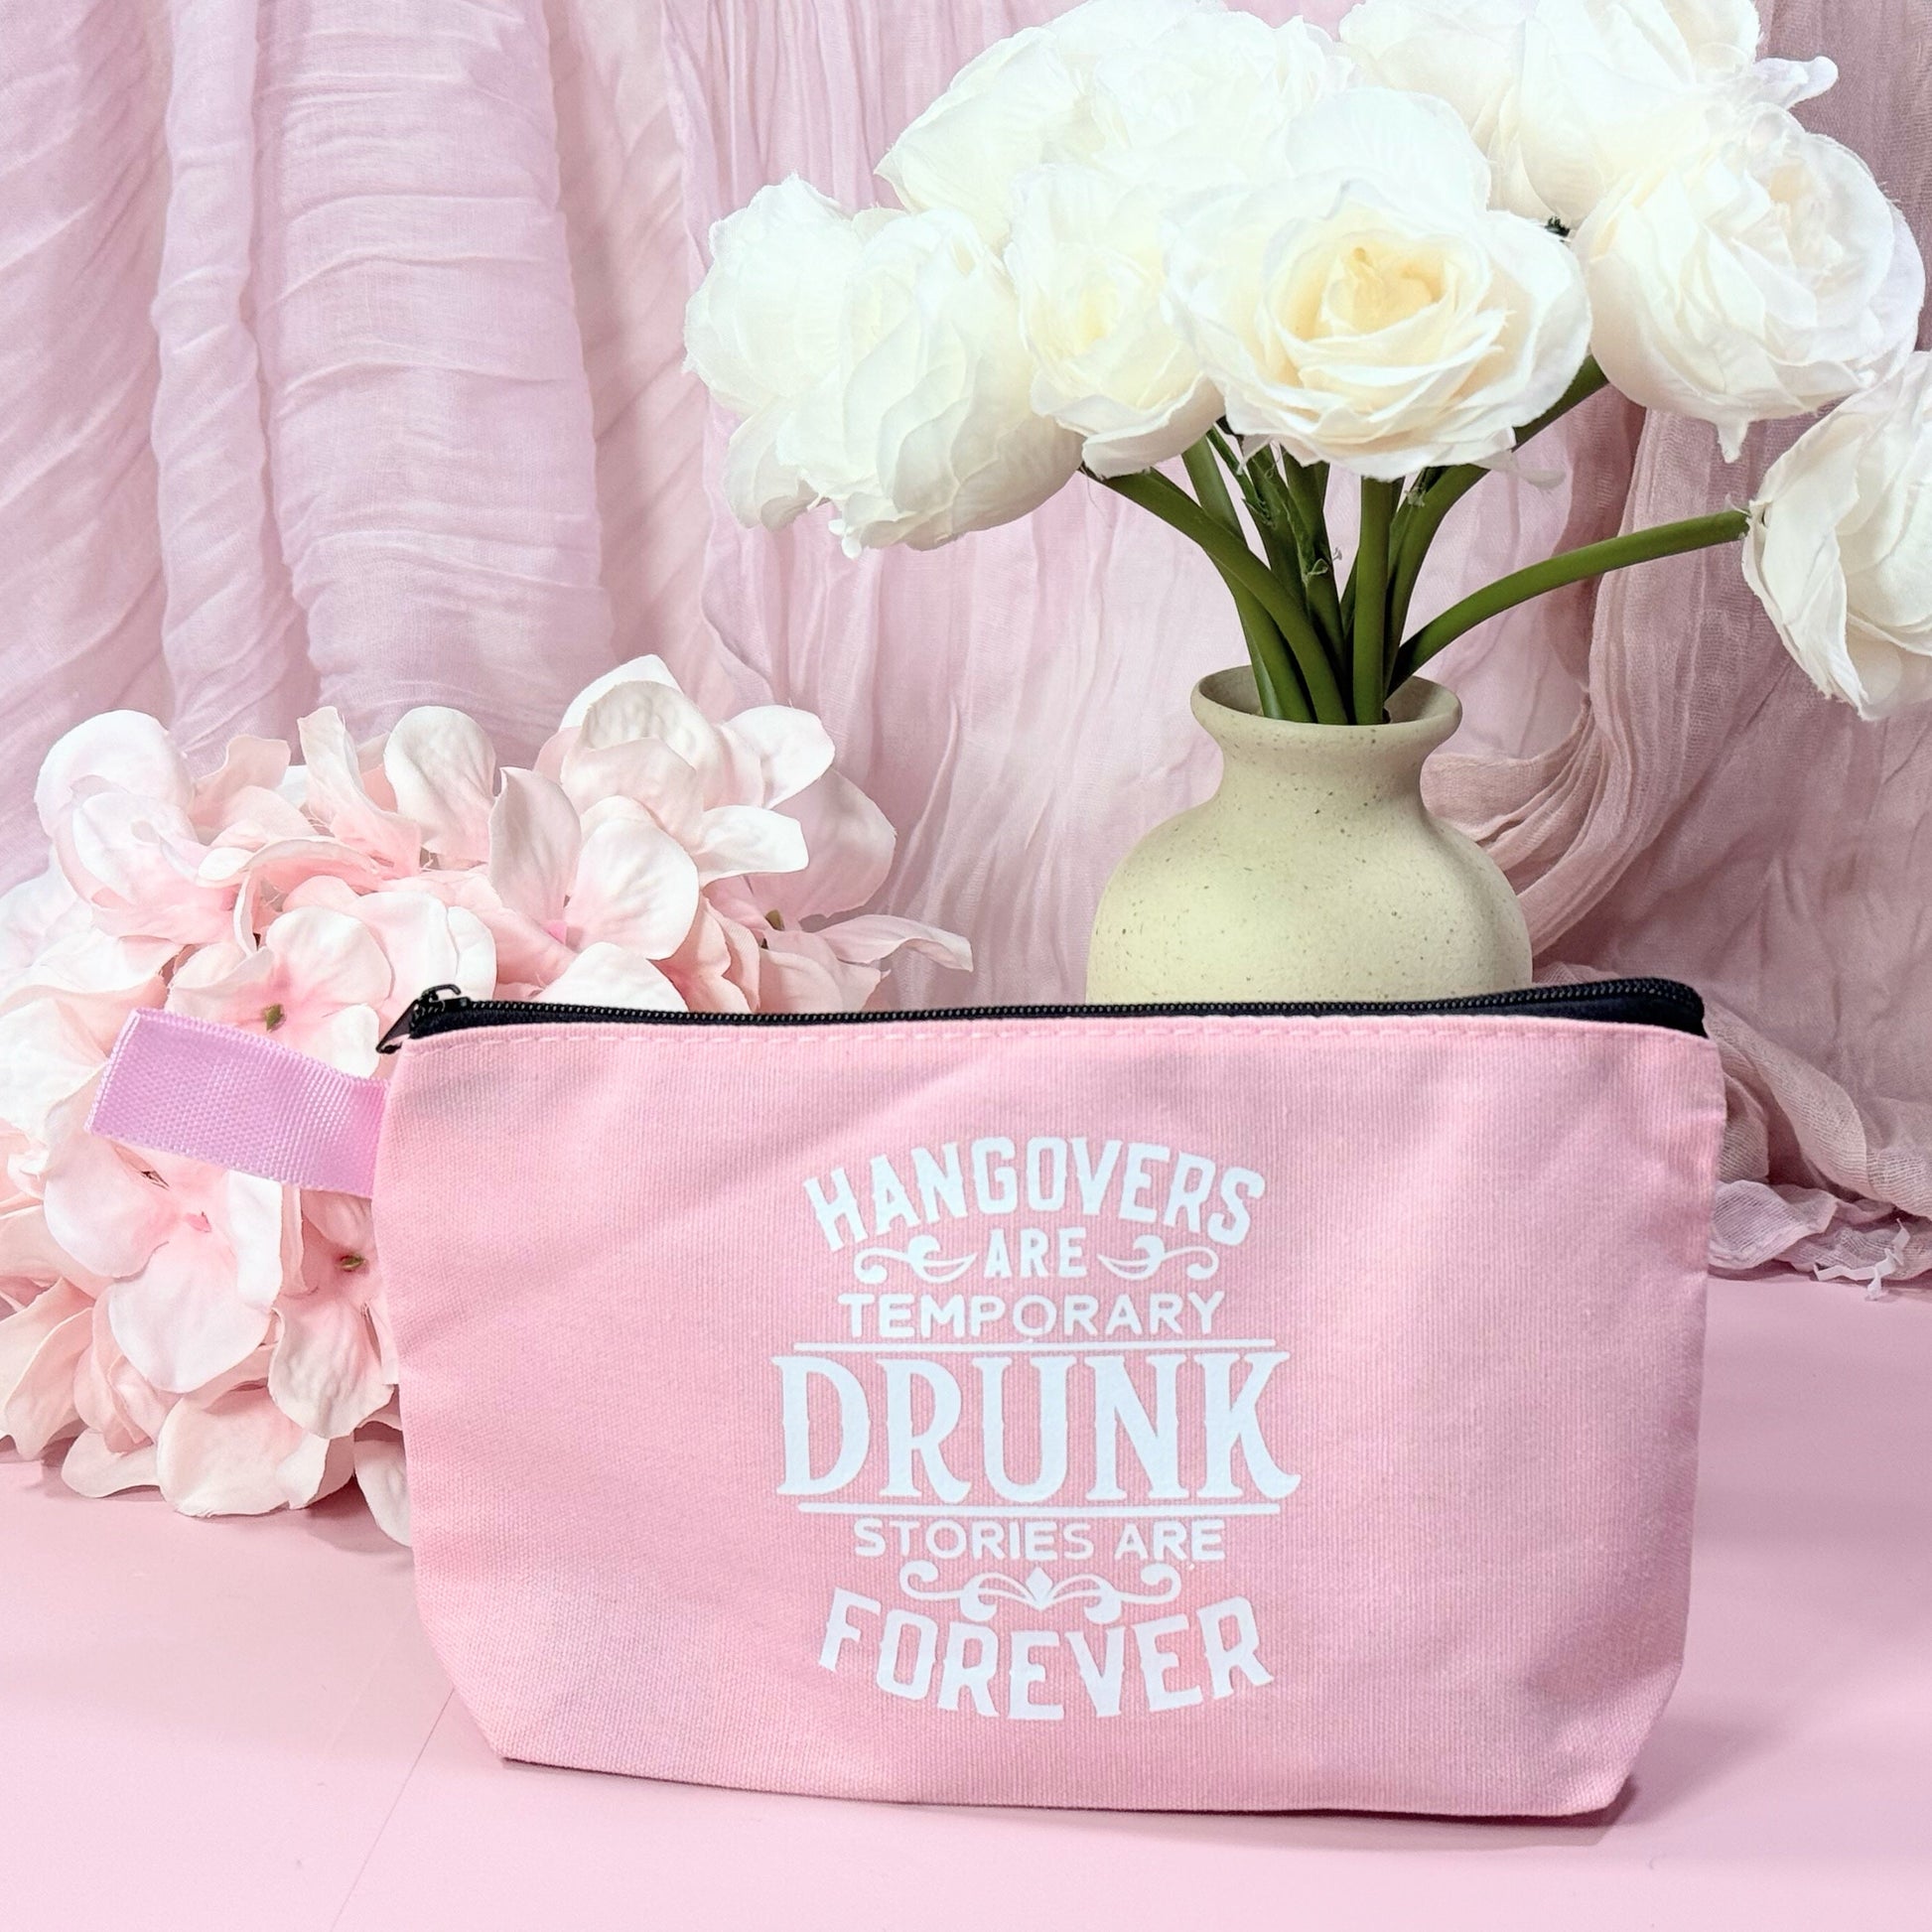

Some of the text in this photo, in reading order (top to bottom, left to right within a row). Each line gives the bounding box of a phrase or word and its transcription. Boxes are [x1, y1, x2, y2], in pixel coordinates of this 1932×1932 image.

[802, 1136, 1267, 1253] HANGOVERS
[983, 1227, 1088, 1280] ARE
[837, 1291, 1226, 1338] TEMPORARY
[770, 1351, 1302, 1504] DRUNK
[854, 1518, 1226, 1563] STORIES ARE
[817, 1587, 1275, 1722] FOREVER
